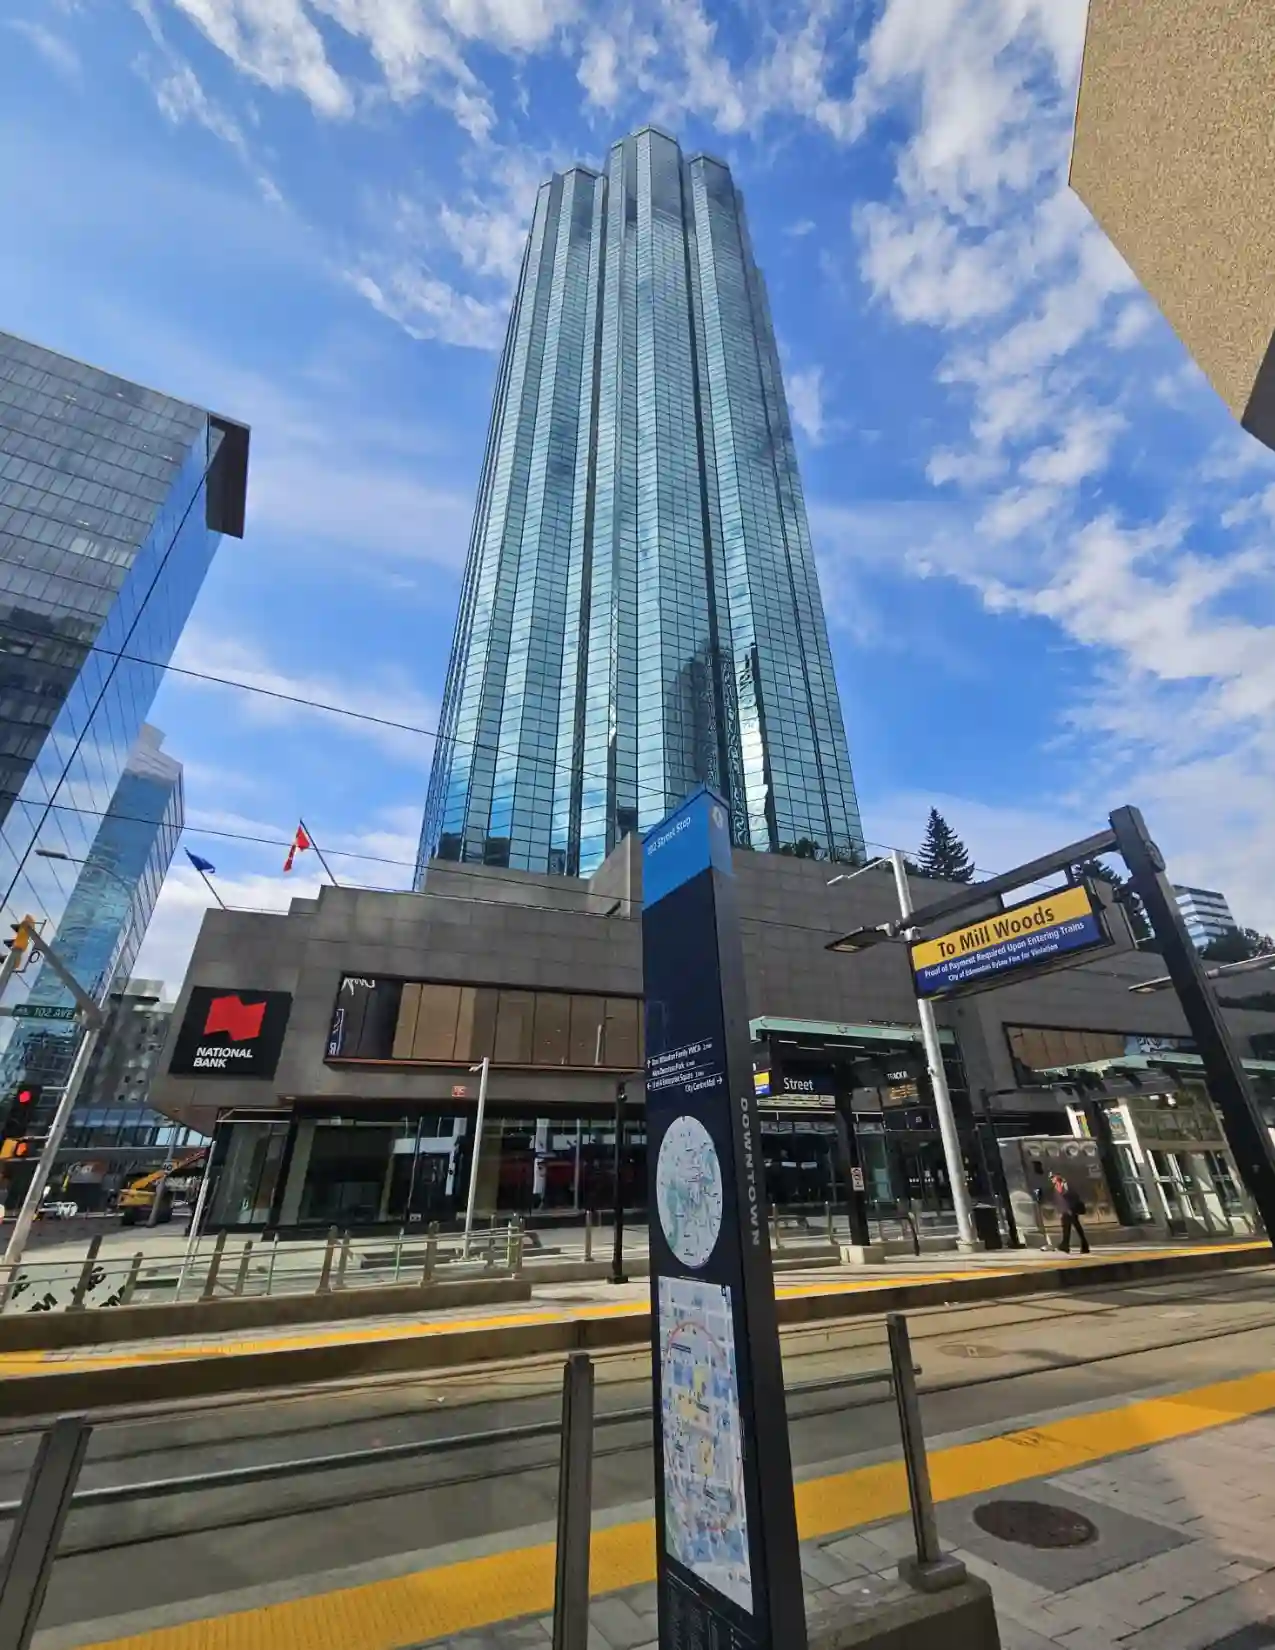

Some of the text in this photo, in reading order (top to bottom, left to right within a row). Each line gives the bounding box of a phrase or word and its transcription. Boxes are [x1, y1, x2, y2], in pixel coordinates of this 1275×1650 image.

[657, 827, 676, 848] Street
[676, 817, 691, 833] Stop
[937, 906, 1055, 957] To Mill Woods
[924, 922, 1085, 978] Proof of Payment Required Upon Entering Trains
[948, 974, 959, 982] City
[960, 971, 965, 979] of
[992, 960, 1008, 970] Bylaw
[1008, 956, 1020, 964] Fine
[1021, 951, 1030, 961] for
[1030, 944, 1058, 957] Violation
[34, 1008, 52, 1017] 102
[53, 1009, 73, 1018] AVE
[194, 1057, 227, 1068] BANK
[196, 1047, 253, 1058] NATIONAL
[783, 1077, 814, 1091] Street
[740, 1097, 760, 1246] DOWNTOWN
